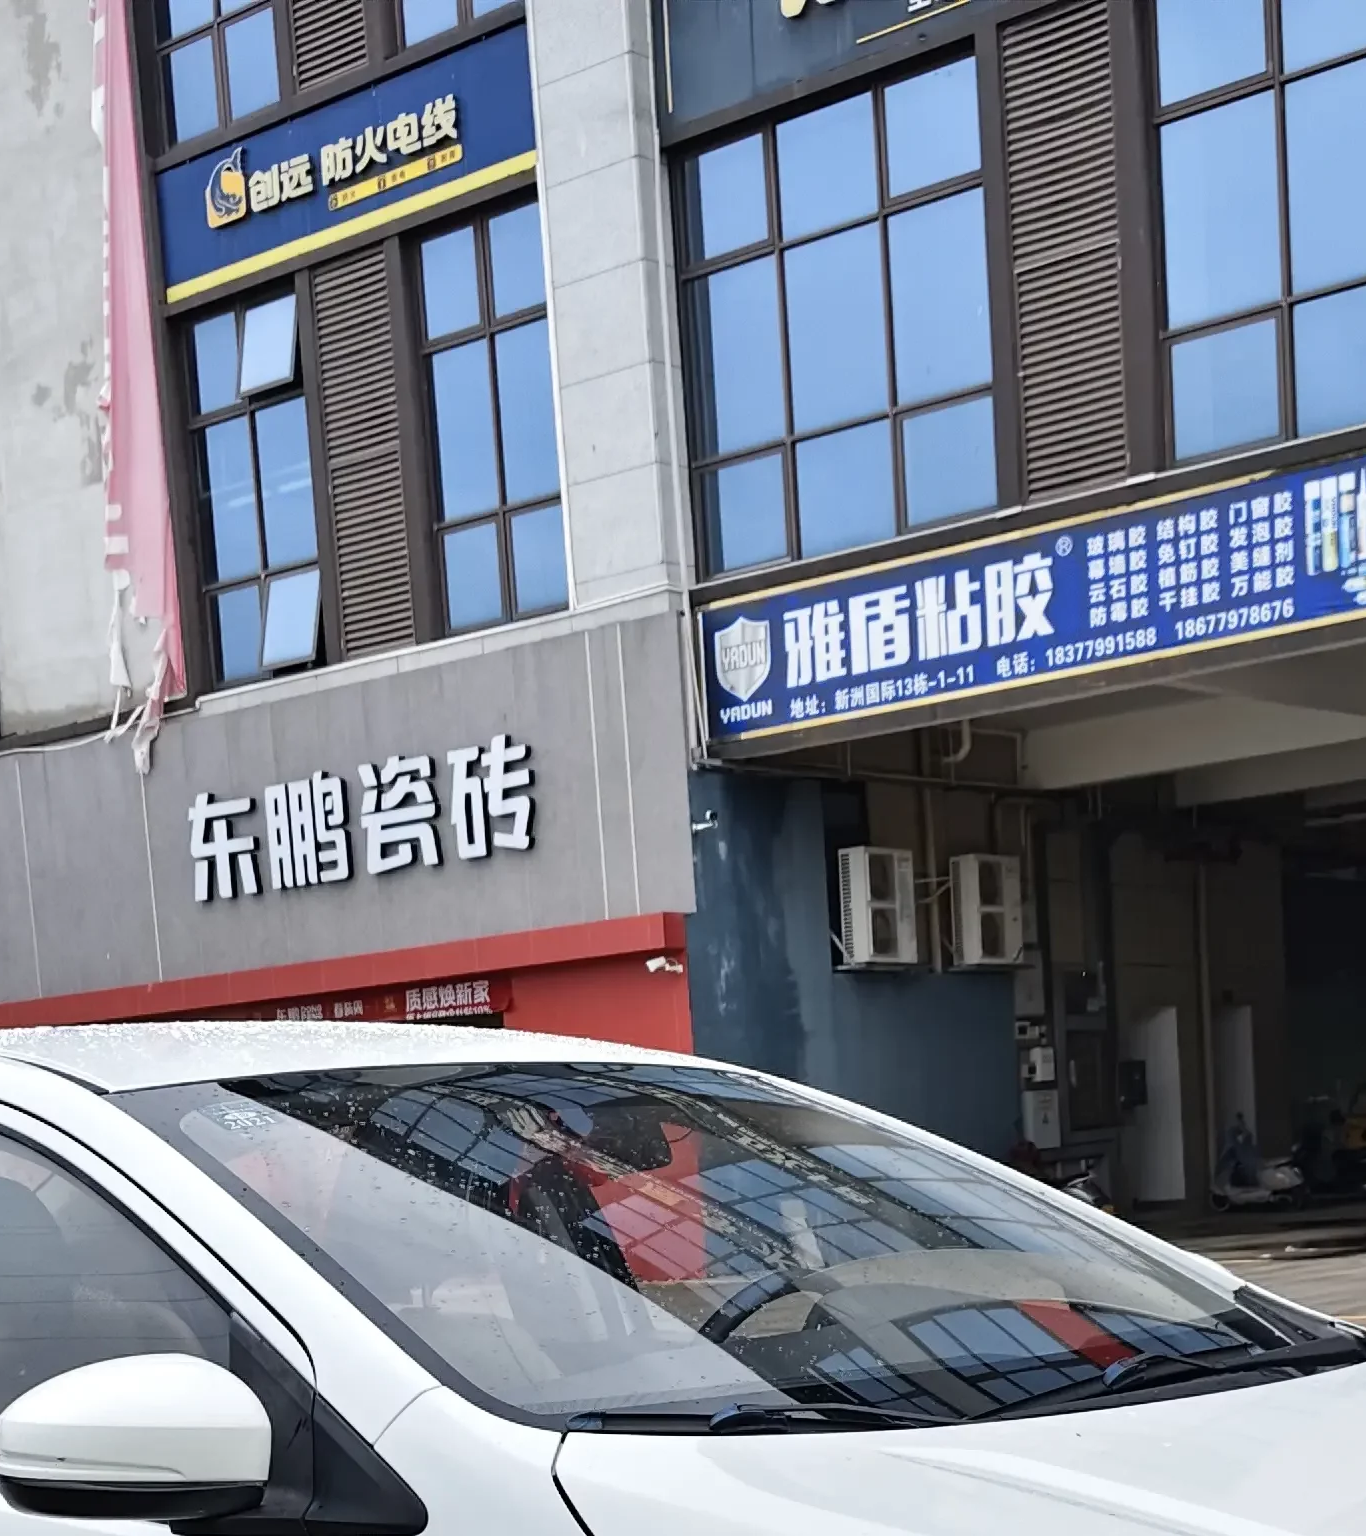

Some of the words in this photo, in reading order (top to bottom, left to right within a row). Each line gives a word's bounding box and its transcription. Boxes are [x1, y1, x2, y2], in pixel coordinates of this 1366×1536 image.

[248, 153, 313, 213] 创远
[321, 94, 458, 187] 防火电线
[1086, 525, 1147, 557] 玻璃胶
[1156, 508, 1218, 541] 结构胶
[1228, 491, 1293, 525] 门窗胶
[1087, 549, 1148, 580] 幕墙胶
[1157, 532, 1219, 566] 免钉胶
[1229, 515, 1294, 549] 发泡胶
[1088, 573, 1149, 604] 云石胶
[1158, 556, 1220, 589] 植筋胶
[1230, 540, 1294, 574] 美缝剂
[1089, 597, 1150, 629] 防霉胶
[1159, 582, 1220, 613] 干挂胶
[1230, 565, 1295, 598] 万能胶
[783, 552, 1055, 688] 雅盾粘胶
[1045, 627, 1158, 667] 18377991588
[1175, 598, 1295, 641] 18677978676
[721, 641, 766, 671] YADUN
[720, 699, 773, 724] YADUN
[188, 735, 532, 902] 东鹏瓷砖
[405, 979, 491, 1012] 质感焕新家
